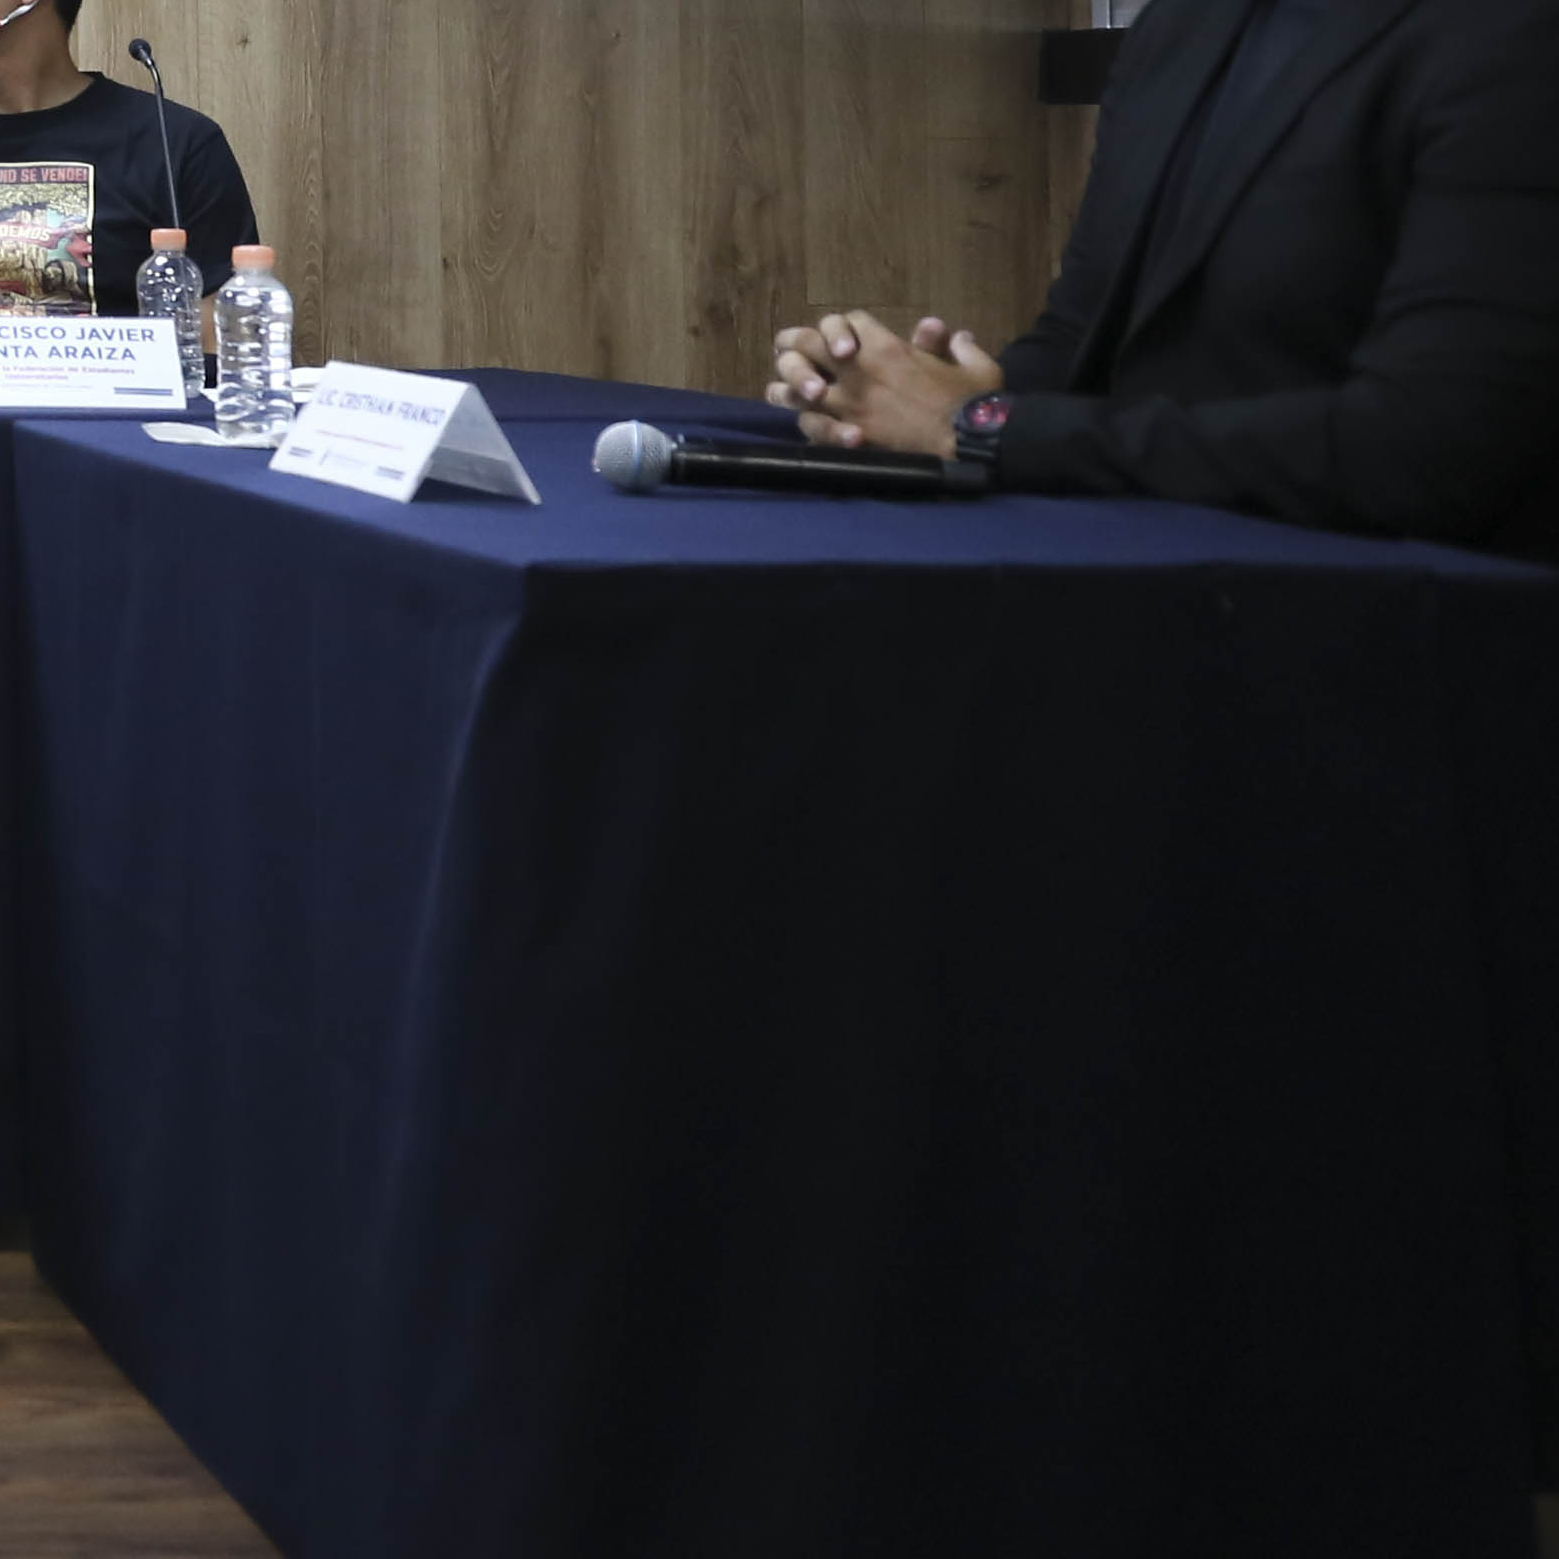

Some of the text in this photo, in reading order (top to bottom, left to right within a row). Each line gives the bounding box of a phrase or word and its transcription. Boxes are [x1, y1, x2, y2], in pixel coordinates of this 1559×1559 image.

[0, 168, 18, 182] NO
[20, 168, 37, 182] SE
[76, 326, 155, 342] JAVIER
[48, 344, 137, 361] ARAIZA
